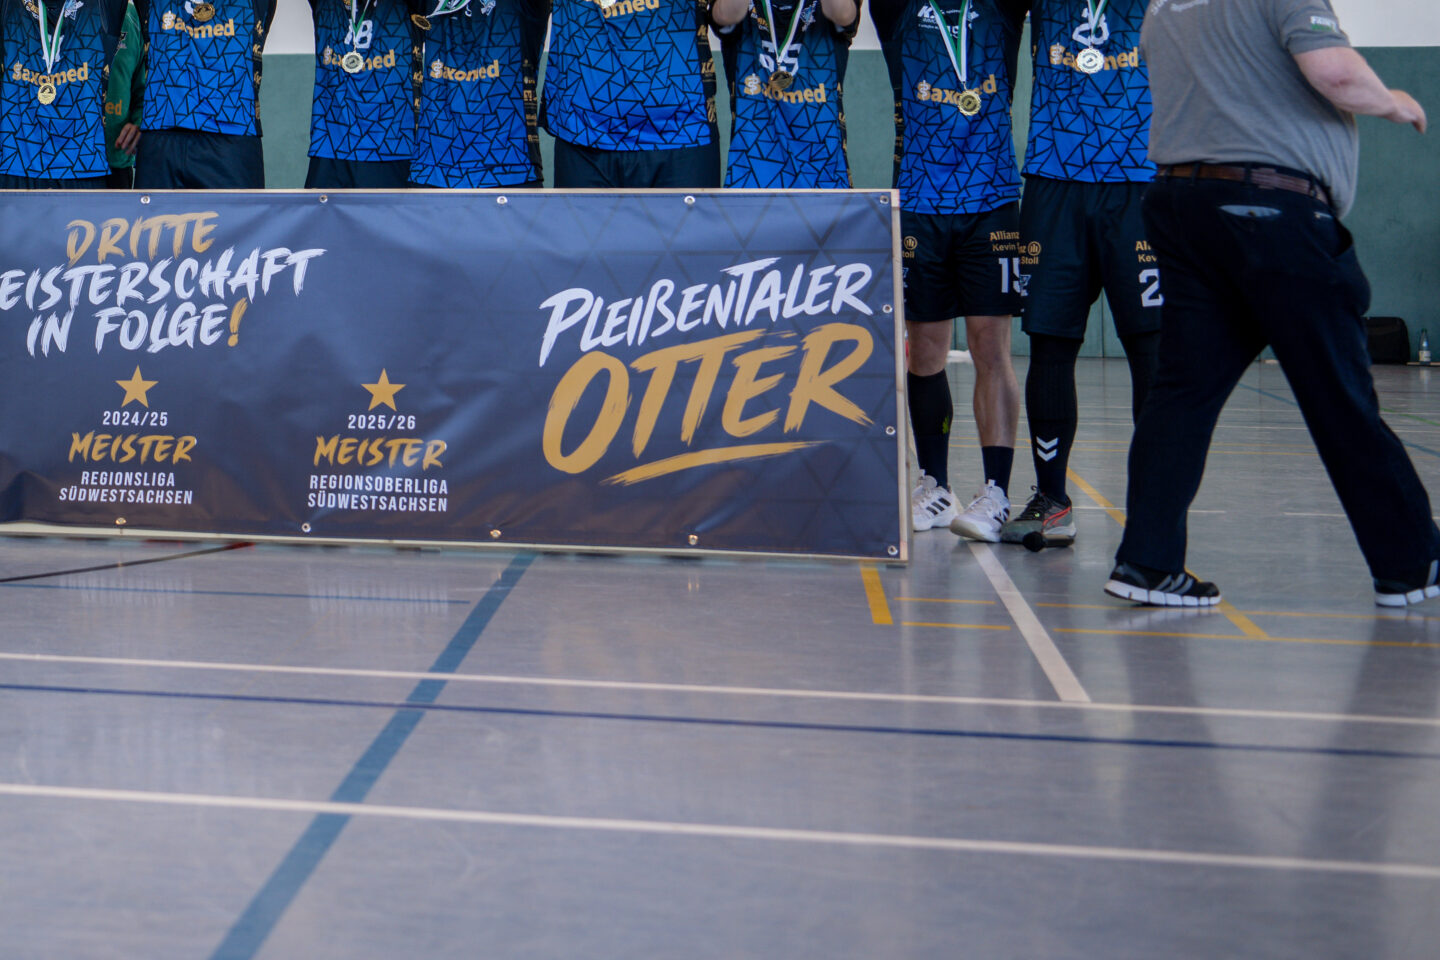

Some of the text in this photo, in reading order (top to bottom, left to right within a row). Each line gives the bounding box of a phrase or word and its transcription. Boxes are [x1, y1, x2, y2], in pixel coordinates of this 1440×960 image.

[65, 210, 219, 267] DRITTE
[26, 296, 249, 358] IN FOLGE!
[542, 322, 875, 474] OTTER
[102, 410, 168, 427] 2024/25
[347, 414, 416, 430] 2025/26
[68, 429, 197, 466] MEISTER
[313, 433, 447, 471] MEISTER
[80, 471, 176, 487] REGIONSLIGA
[309, 474, 449, 495] REGIONSOBERLIGA
[59, 485, 193, 505] SÜDWESTSACHSEN
[307, 490, 448, 512] SÜDWESTSACHSEN
